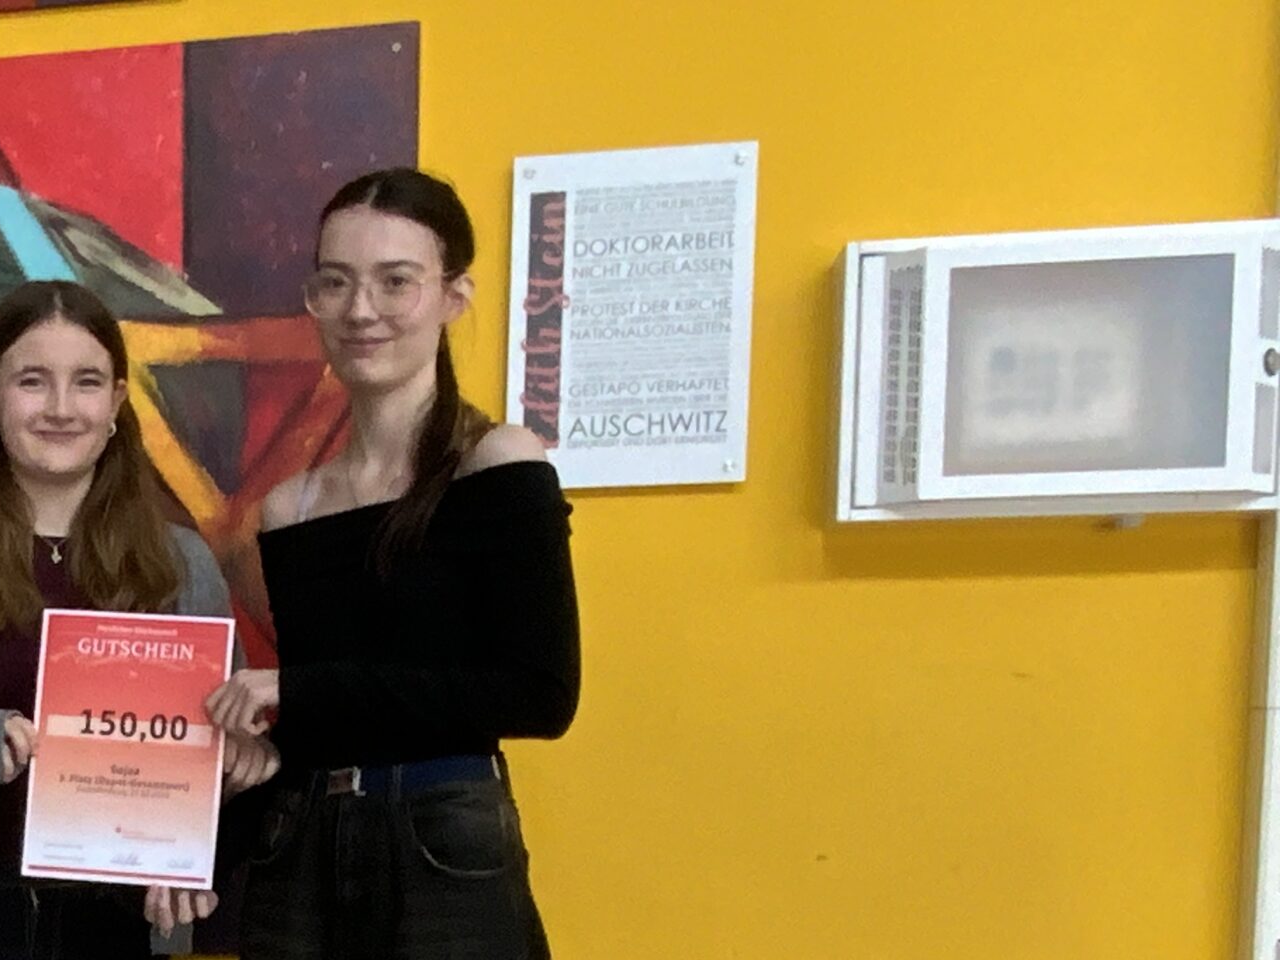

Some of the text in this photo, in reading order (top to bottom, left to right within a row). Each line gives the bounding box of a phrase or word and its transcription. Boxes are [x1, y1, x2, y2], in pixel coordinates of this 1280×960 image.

[573, 230, 735, 258] DOKTORARBEIT
[572, 257, 733, 280] NICHT ZUGELASSEN
[571, 296, 732, 318] PROTEST DER KIRCHE
[569, 377, 730, 397] GESTAPO VERHAFTET
[568, 410, 728, 439] AUSCHWITZ
[78, 637, 195, 661] GUTSCHEIN
[80, 708, 189, 742] 150,00
